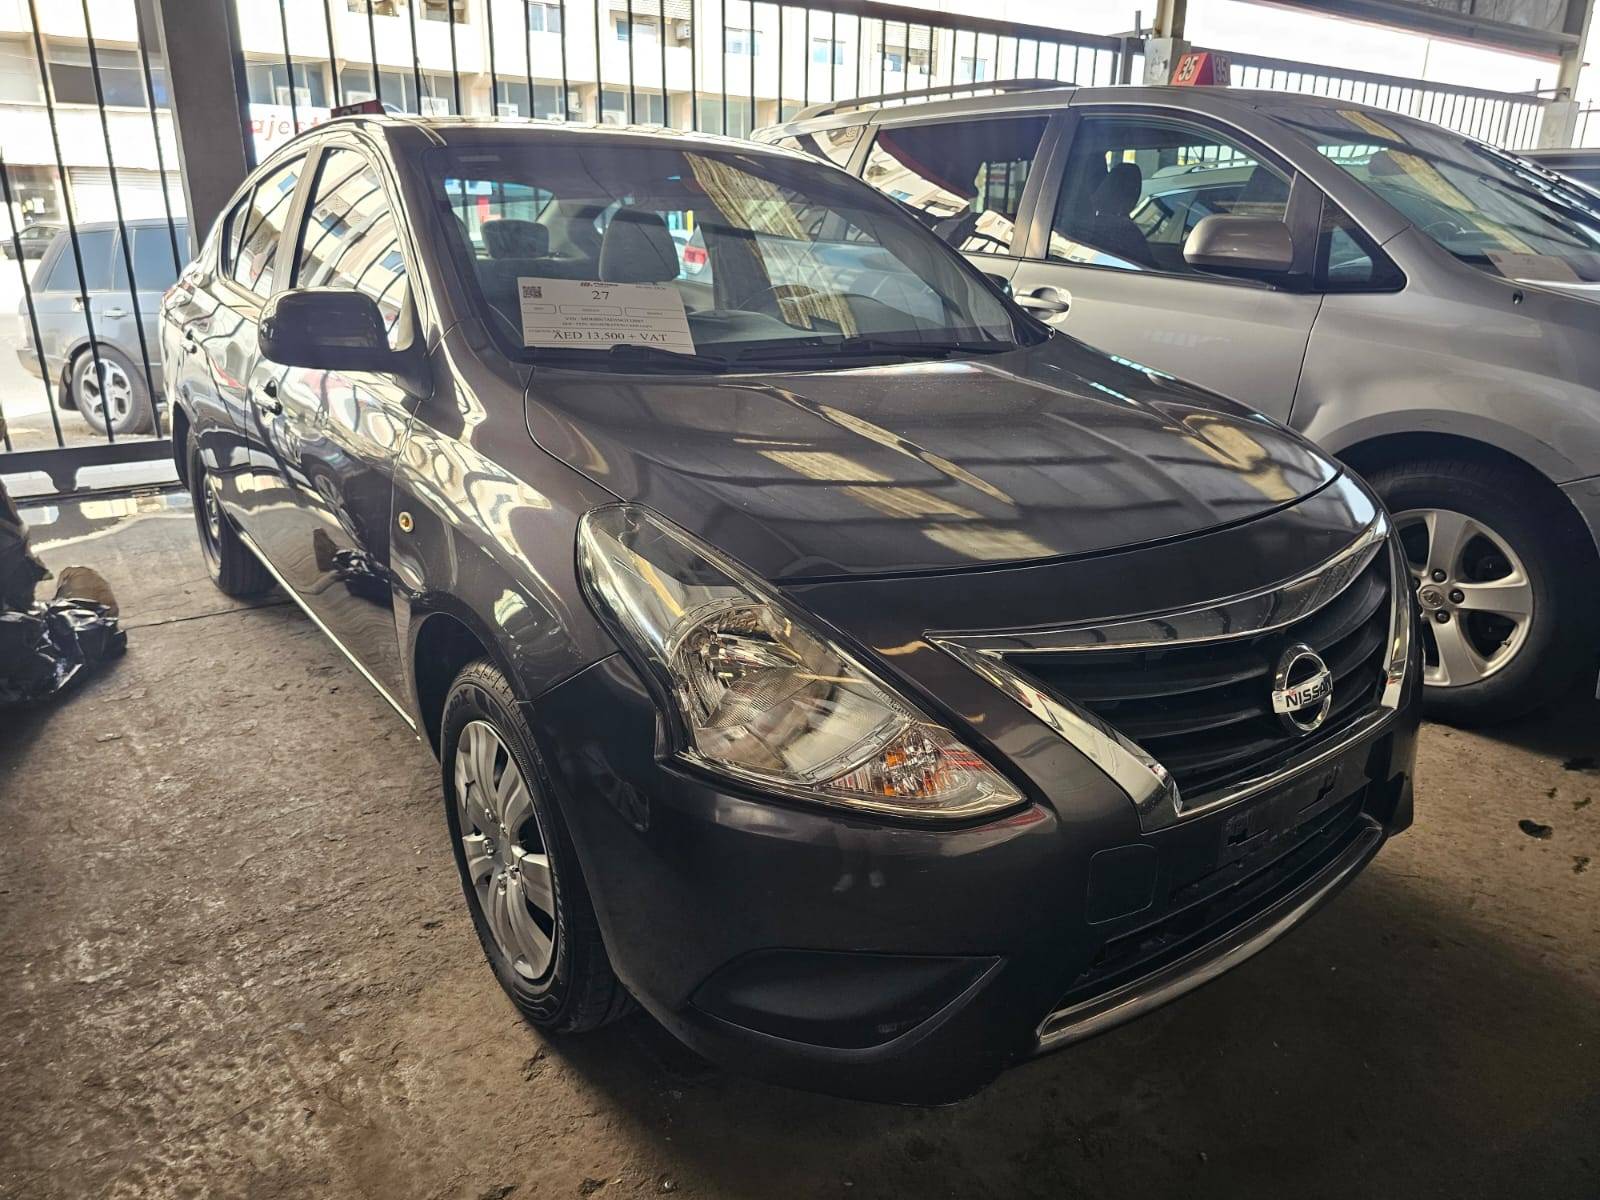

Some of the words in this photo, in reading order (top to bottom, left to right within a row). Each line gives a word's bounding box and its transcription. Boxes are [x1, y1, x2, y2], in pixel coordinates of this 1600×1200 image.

[1178, 55, 1199, 81] 35
[248, 114, 331, 141] ajest
[591, 290, 610, 300] 27
[553, 330, 583, 340] AED
[586, 331, 625, 341] 13,500
[639, 333, 668, 342] VAT
[1285, 674, 1332, 707] NISSAN
